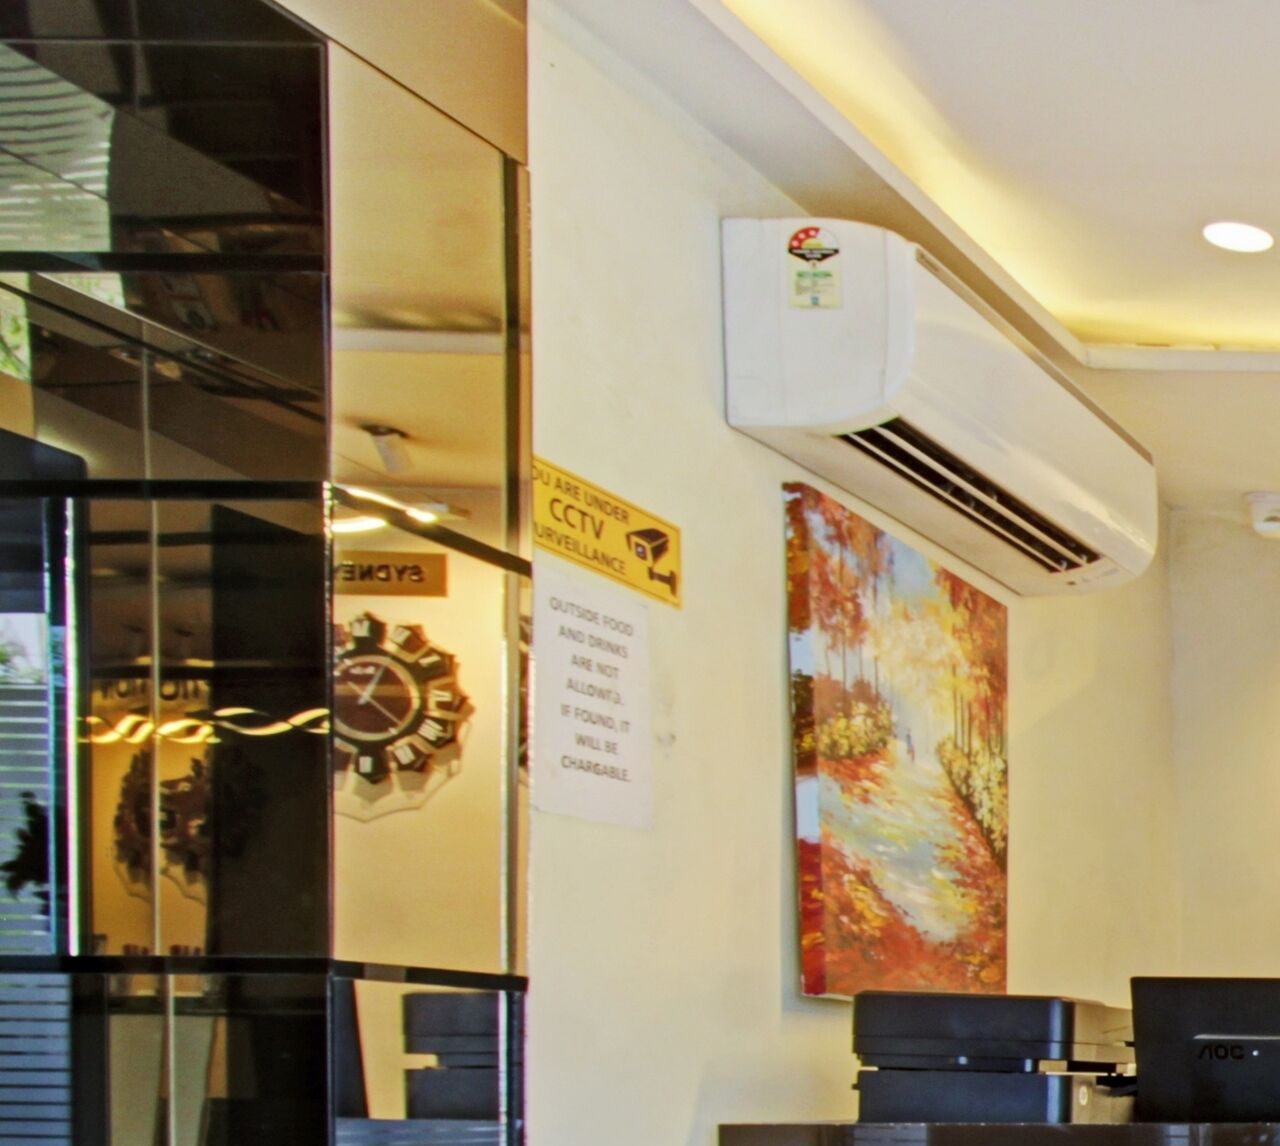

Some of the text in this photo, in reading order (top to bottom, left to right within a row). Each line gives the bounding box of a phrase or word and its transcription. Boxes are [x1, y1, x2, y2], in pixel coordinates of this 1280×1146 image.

[532, 465, 630, 525] OU ARE UNDER
[549, 497, 605, 540] CCTV
[534, 521, 627, 576] URVEILLANCE
[549, 596, 634, 637] OUTSIDE FOOD
[558, 625, 628, 659] AND DRINKS
[571, 654, 619, 680] ARE NOT
[560, 704, 631, 733] IF FOUND, IT
[575, 733, 619, 756] WILL BE
[1197, 1043, 1245, 1061] AOC
